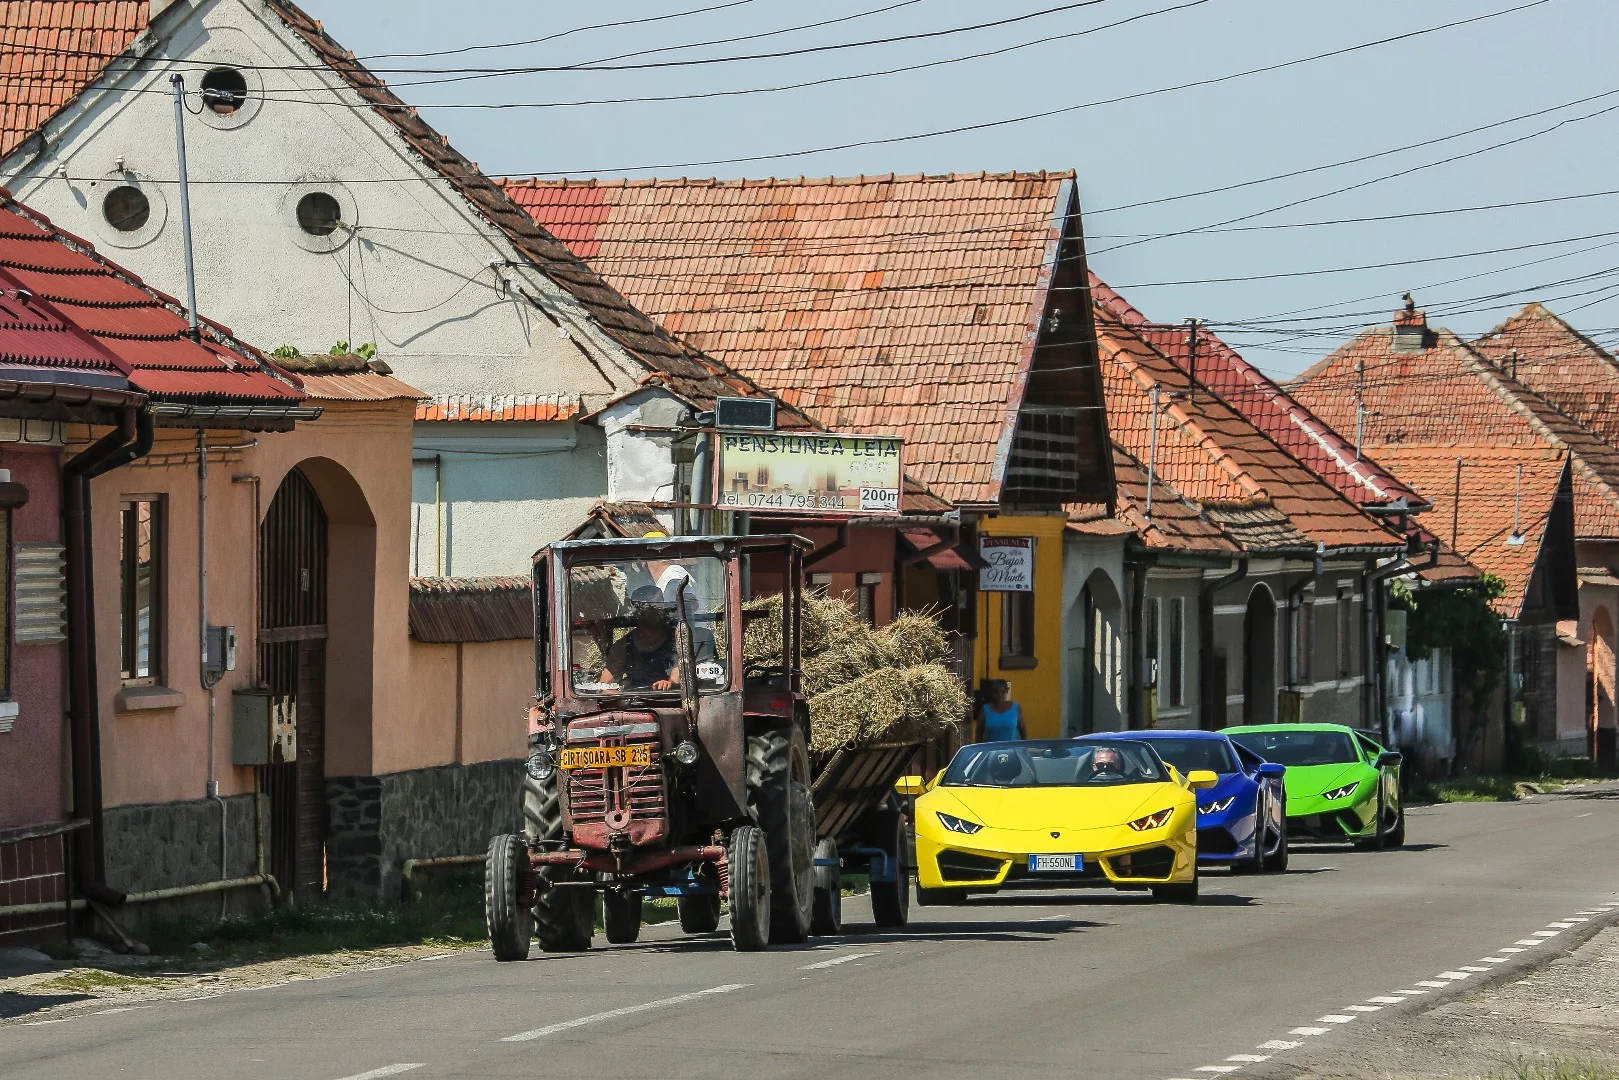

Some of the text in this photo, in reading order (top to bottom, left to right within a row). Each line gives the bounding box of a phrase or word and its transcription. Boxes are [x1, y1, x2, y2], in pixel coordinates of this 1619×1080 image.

[724, 434, 897, 457] PENSIUNEA LEIA
[723, 493, 846, 509] tel. 0744 795 344
[990, 551, 1024, 568] Bujor
[987, 569, 1025, 583] Munte
